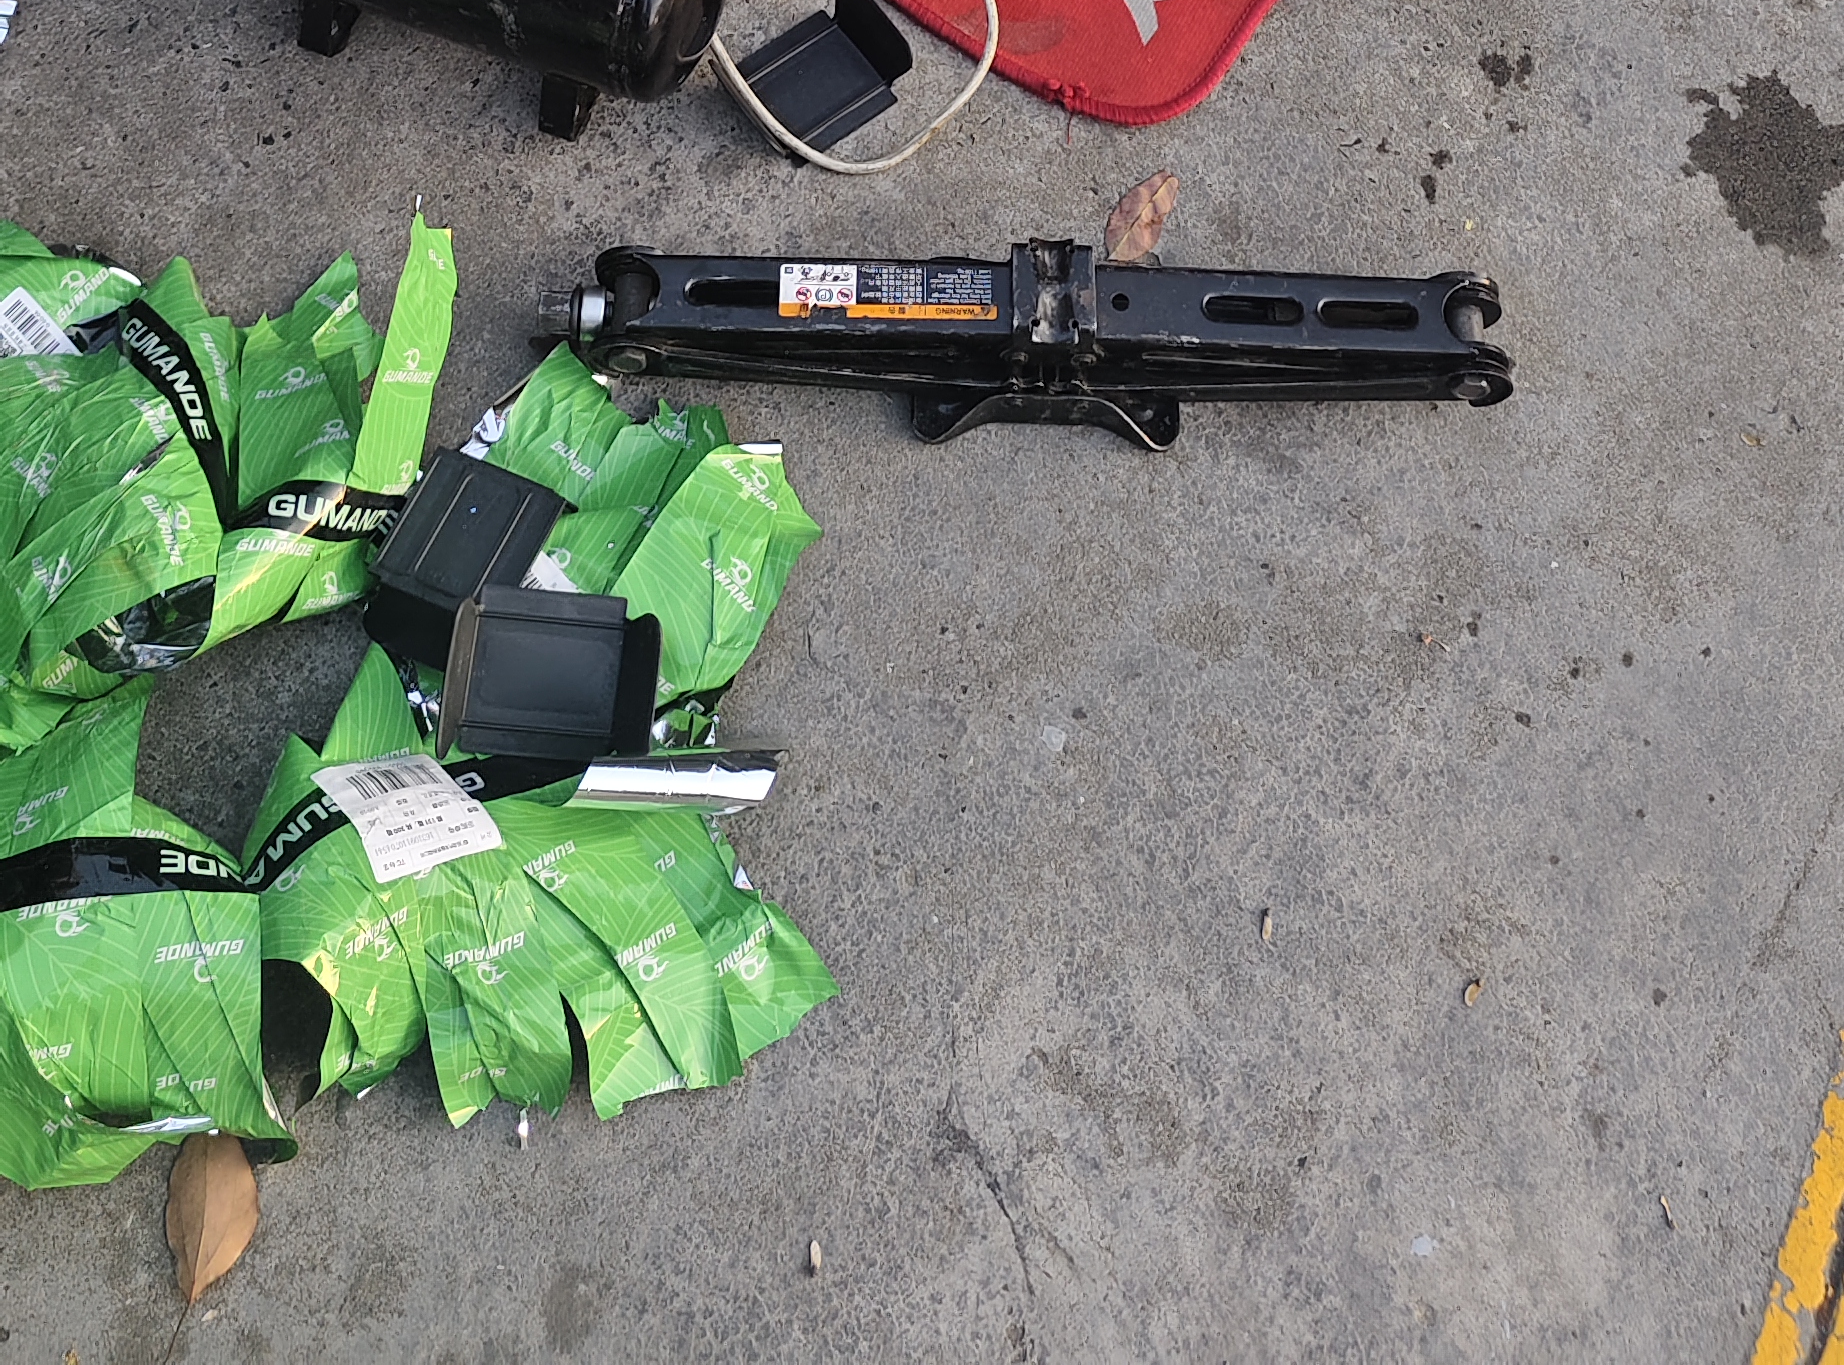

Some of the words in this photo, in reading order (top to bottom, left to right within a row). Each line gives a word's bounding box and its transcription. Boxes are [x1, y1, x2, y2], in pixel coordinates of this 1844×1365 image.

[56, 267, 111, 324] GUMAND
[934, 306, 976, 316] WARNING
[121, 317, 212, 441] GUMANDE
[383, 370, 434, 385] GUMANDE
[720, 459, 779, 513] GUMAND
[268, 493, 399, 536] GUMANDE
[236, 538, 316, 558] GUMANDE
[701, 558, 757, 612] GUMAND
[18, 785, 69, 814] GUMA
[522, 839, 576, 876] GUMAN
[345, 906, 409, 960] GUMANDE
[443, 930, 525, 969] GUMANDE
[615, 921, 678, 970] GUMAND
